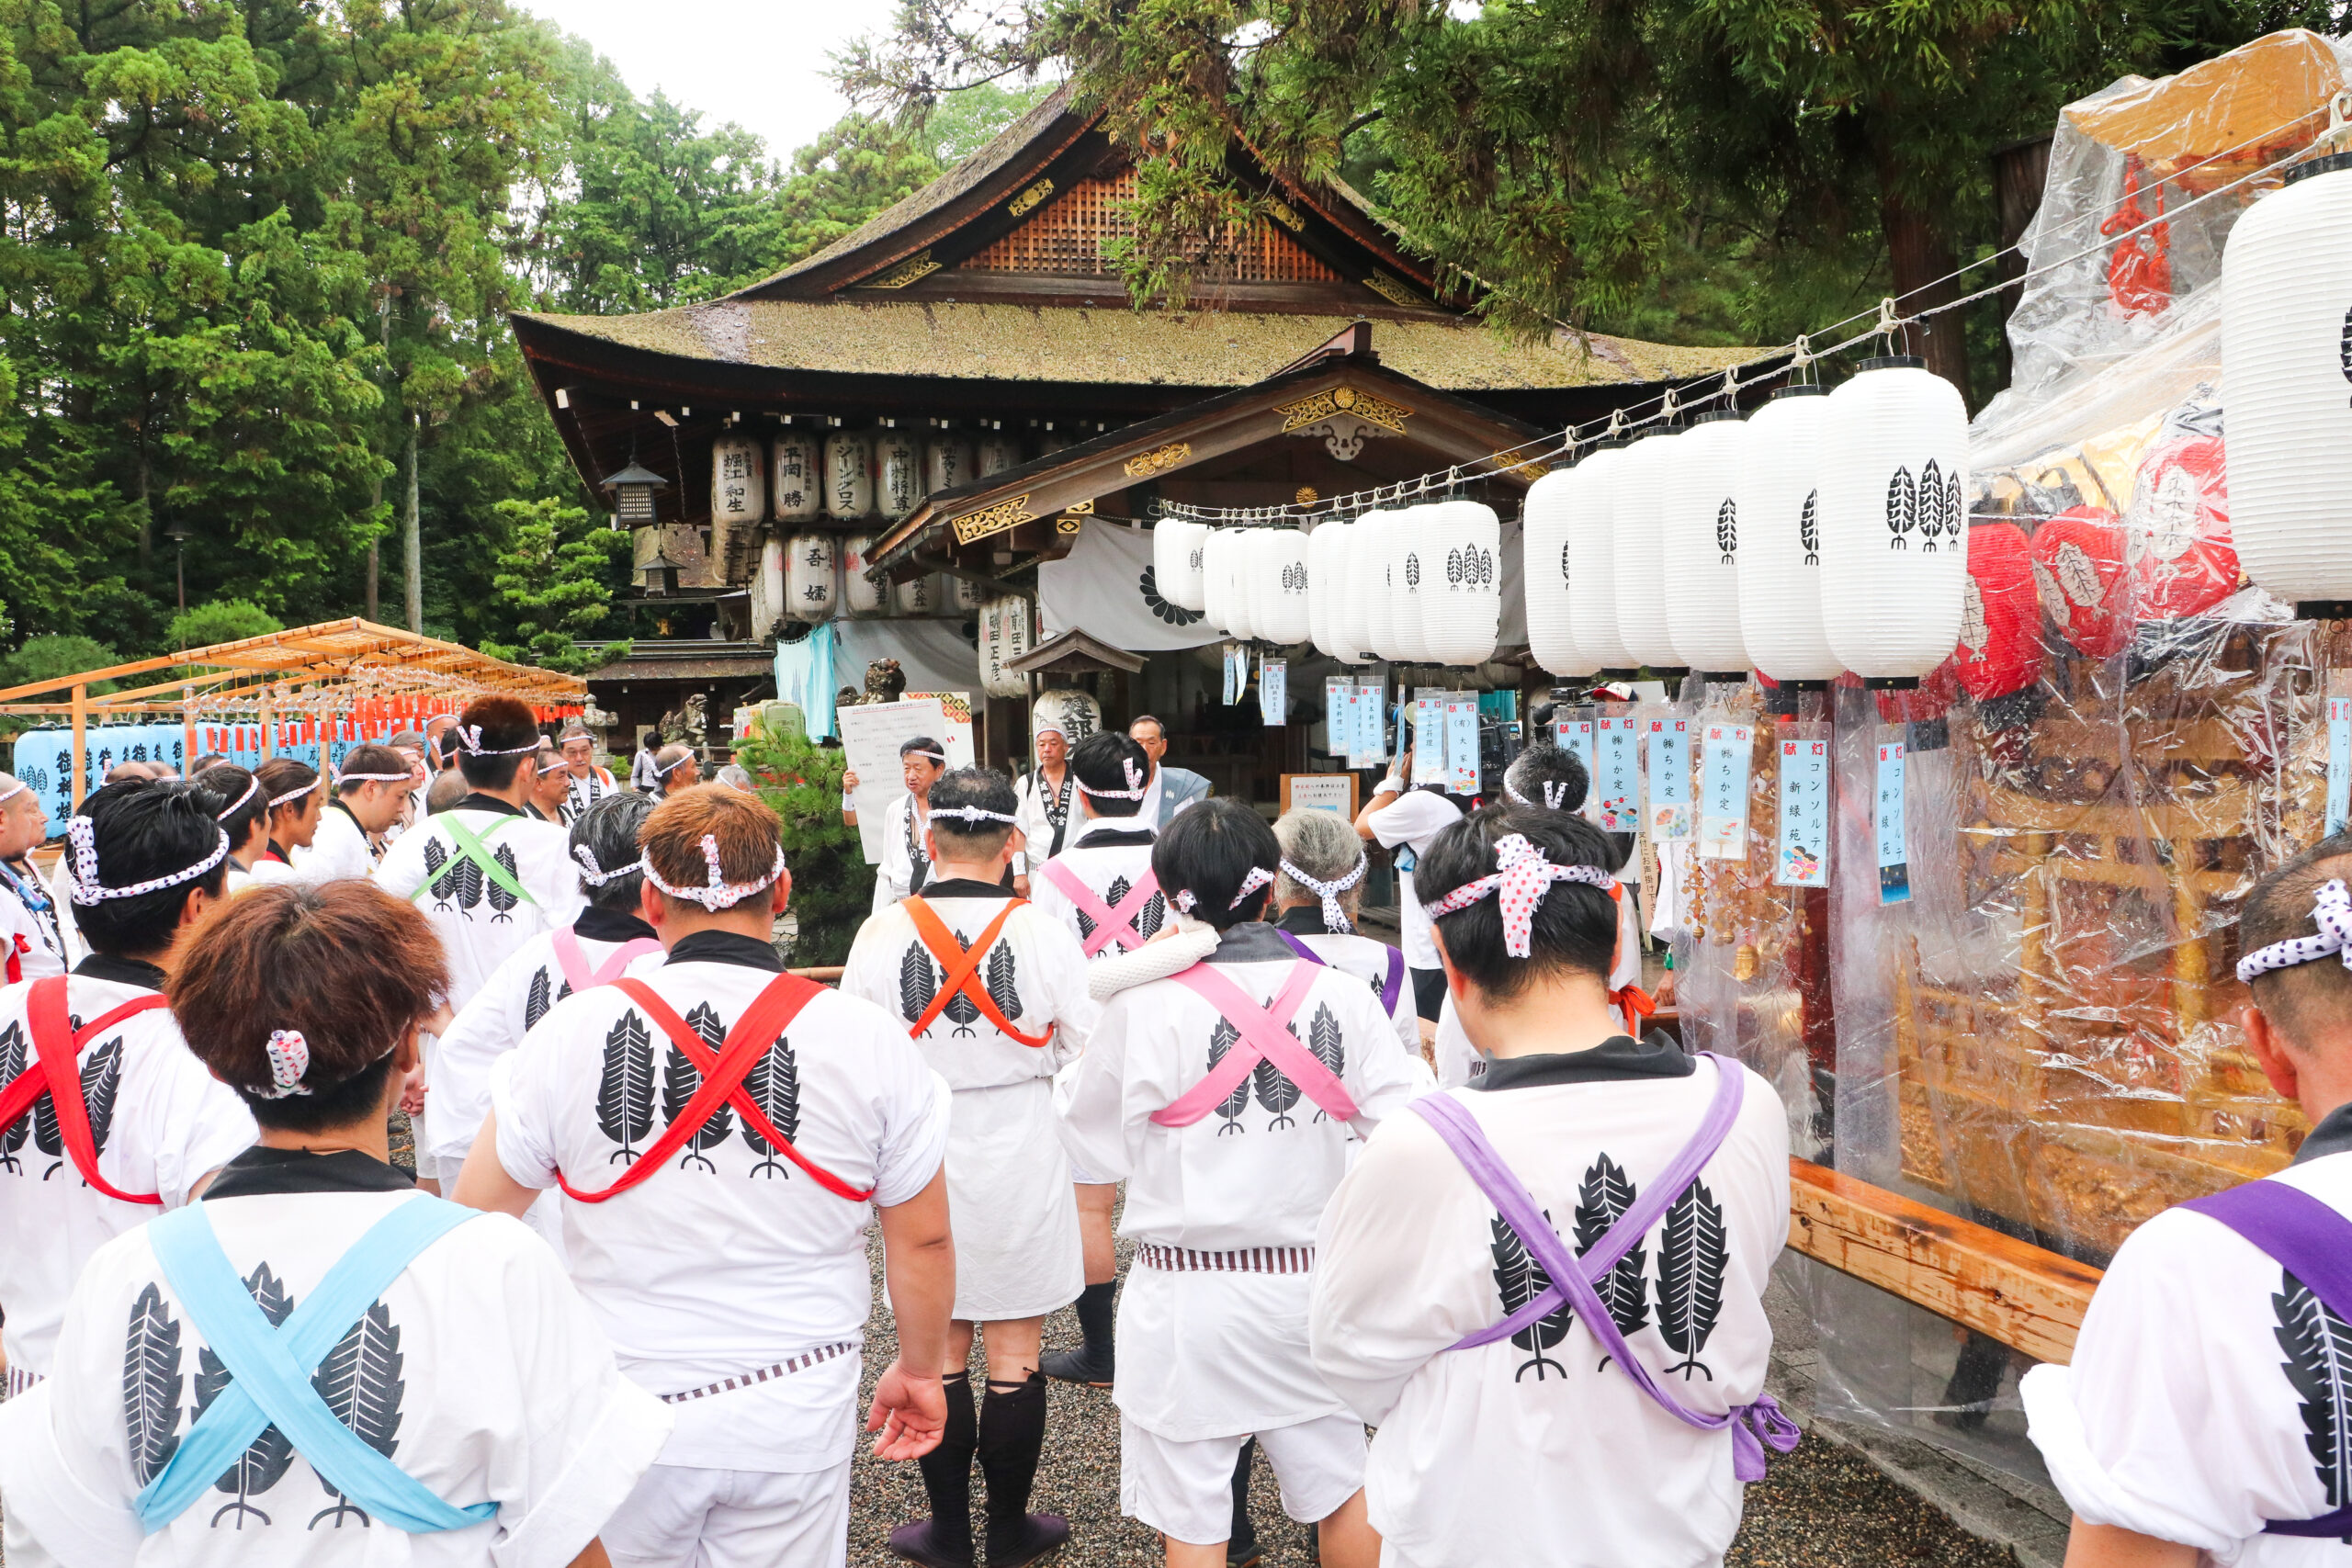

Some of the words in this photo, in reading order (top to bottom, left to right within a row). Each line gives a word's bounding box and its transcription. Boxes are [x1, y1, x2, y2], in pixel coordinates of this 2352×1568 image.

[724, 454, 745, 513] 堀江和生
[1039, 781, 1057, 824] 建部大社
[1057, 781, 1071, 827] 近江一の宮
[1788, 781, 1802, 841] 新緑苑
[1810, 762, 1822, 849] コンソルテ
[1882, 790, 1891, 856] 新緑苑
